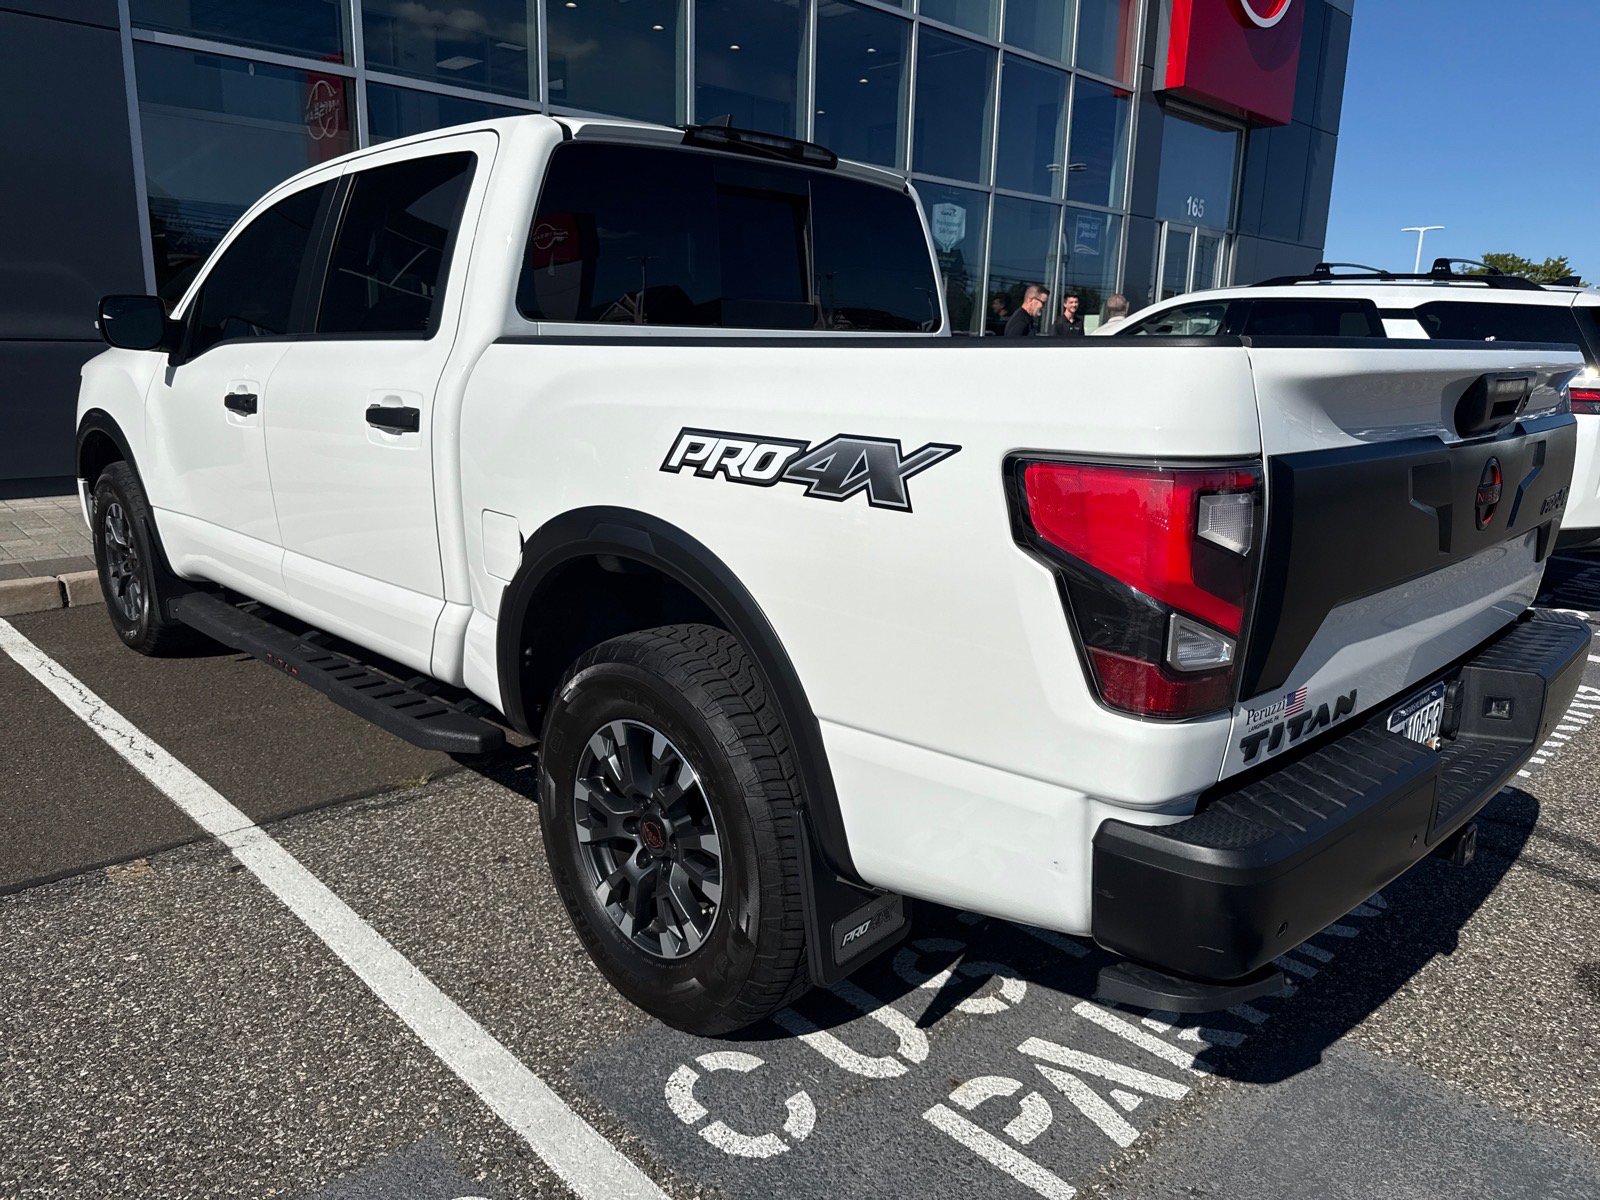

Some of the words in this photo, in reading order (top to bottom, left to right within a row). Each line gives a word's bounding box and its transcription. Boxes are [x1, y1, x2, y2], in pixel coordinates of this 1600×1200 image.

[1186, 195, 1205, 218] 165
[1239, 688, 1358, 763] TITAN
[1246, 694, 1286, 726] Peruzzi
